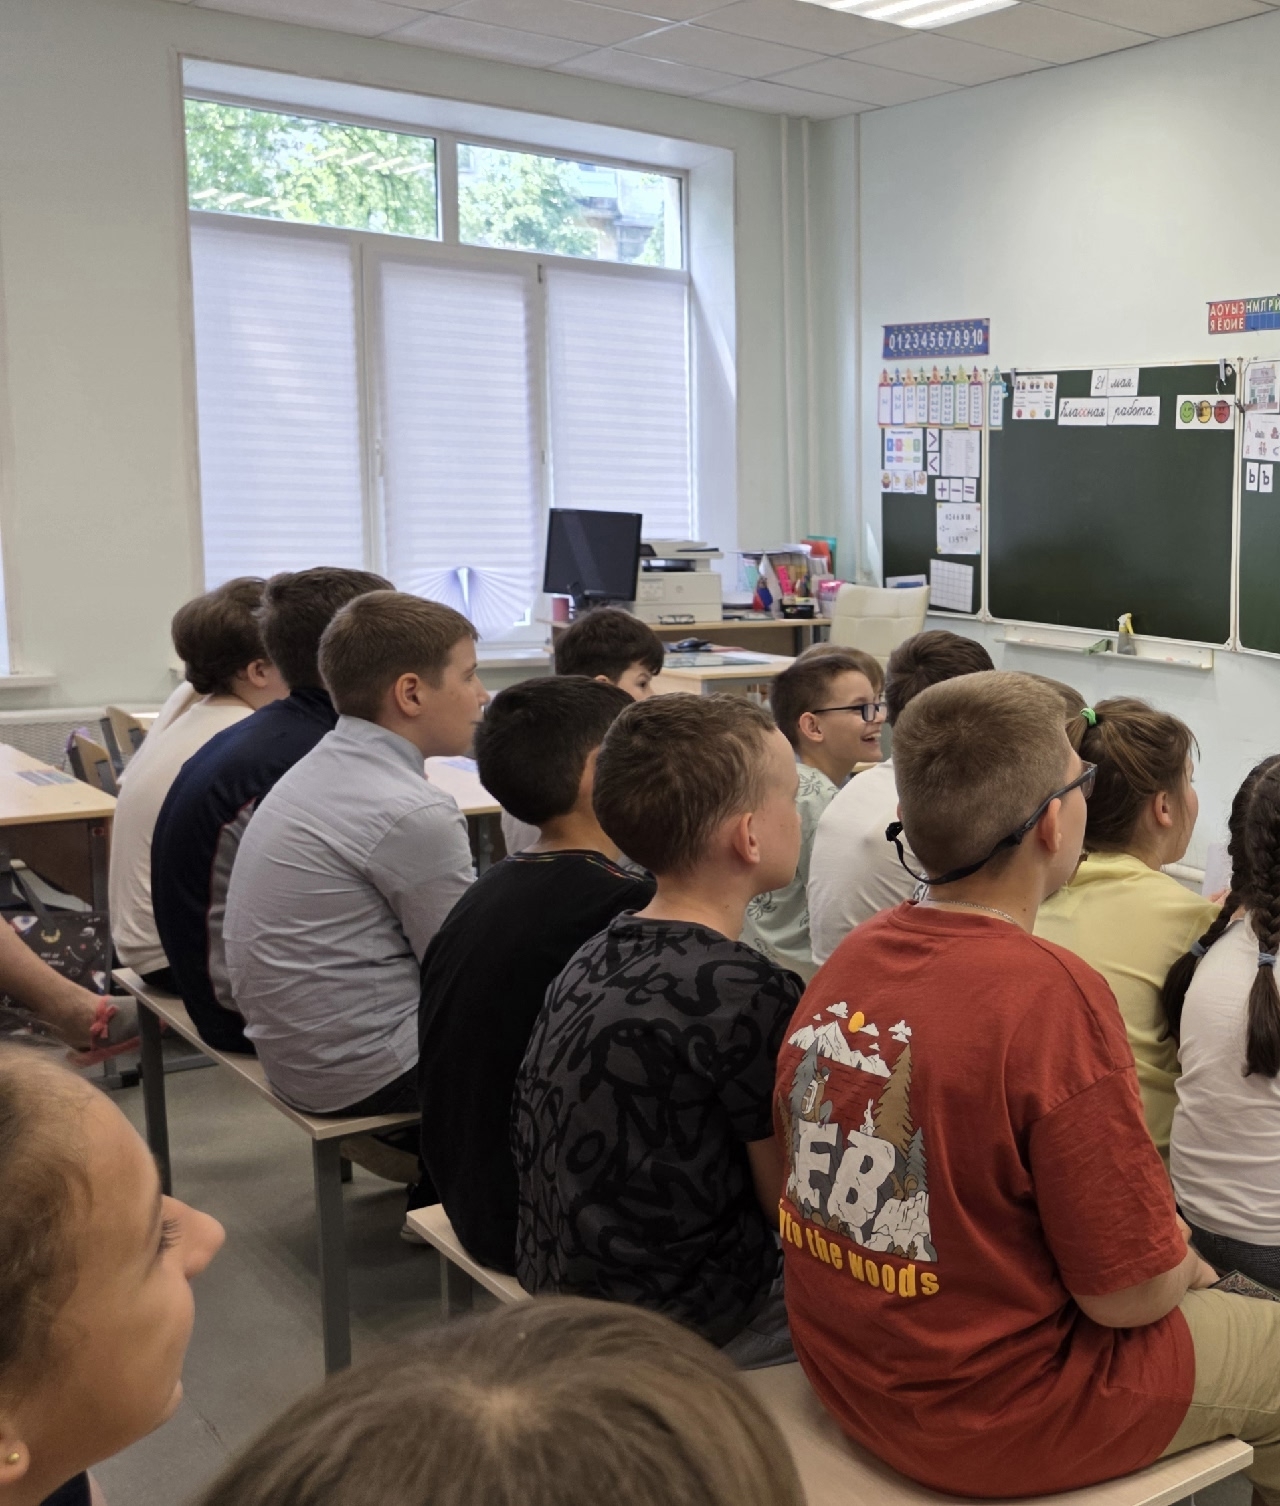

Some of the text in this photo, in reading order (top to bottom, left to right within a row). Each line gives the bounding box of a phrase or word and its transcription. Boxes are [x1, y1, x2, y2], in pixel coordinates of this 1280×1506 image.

[1094, 375, 1105, 390] 21
[1059, 400, 1106, 418] Классная
[778, 1198, 940, 1298] to the woods
